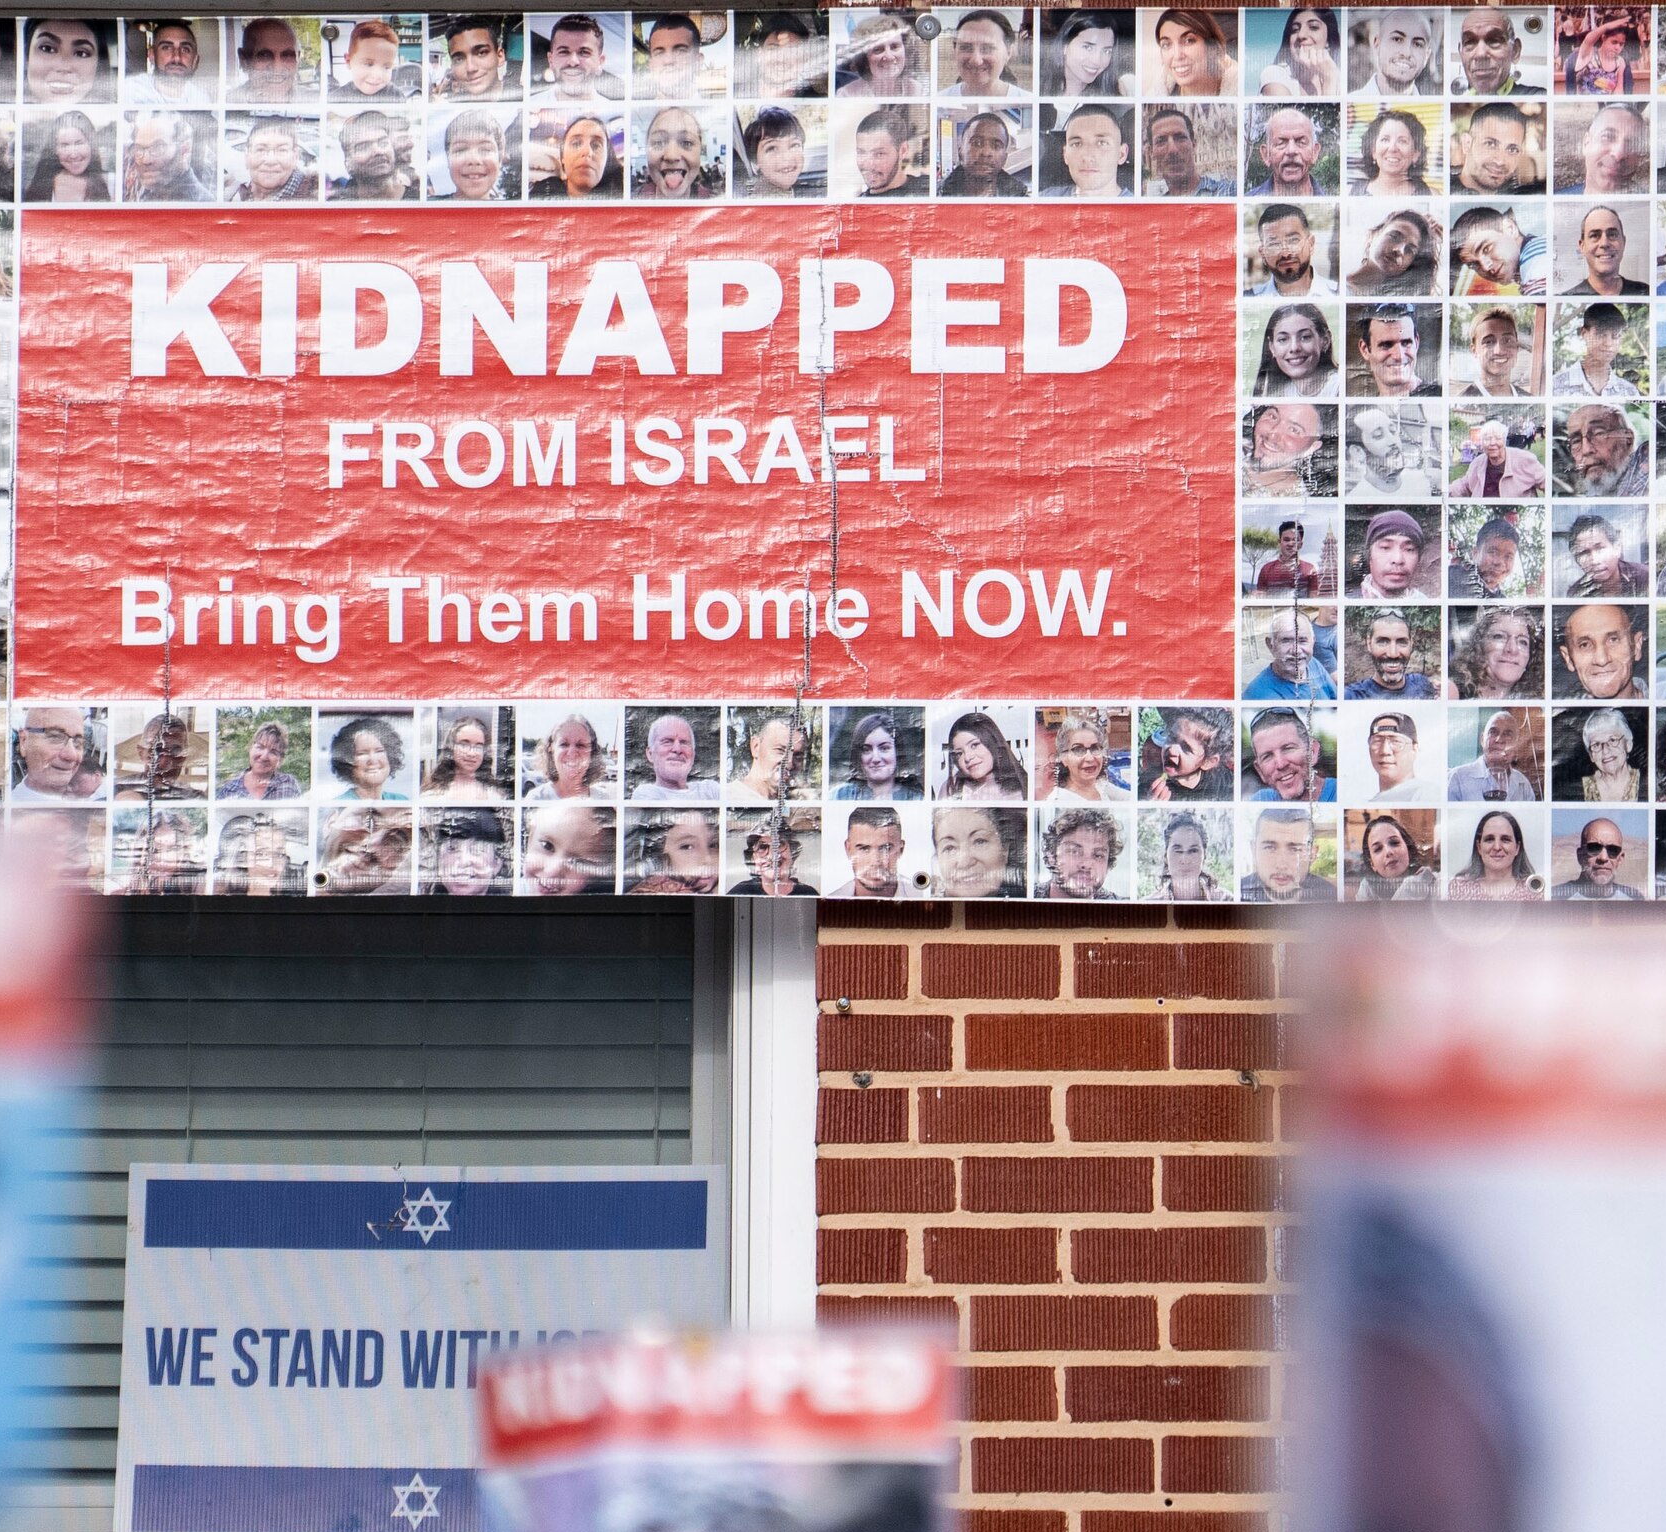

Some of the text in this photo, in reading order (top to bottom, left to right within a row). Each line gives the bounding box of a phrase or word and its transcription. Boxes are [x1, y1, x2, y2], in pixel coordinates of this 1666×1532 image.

[130, 256, 1129, 378] KIDNAPPED
[327, 414, 927, 488] FROM ISRAEL
[119, 568, 1129, 663] Bring Them Home NOW.
[146, 1327, 218, 1387] WE
[231, 1328, 384, 1389] STAND
